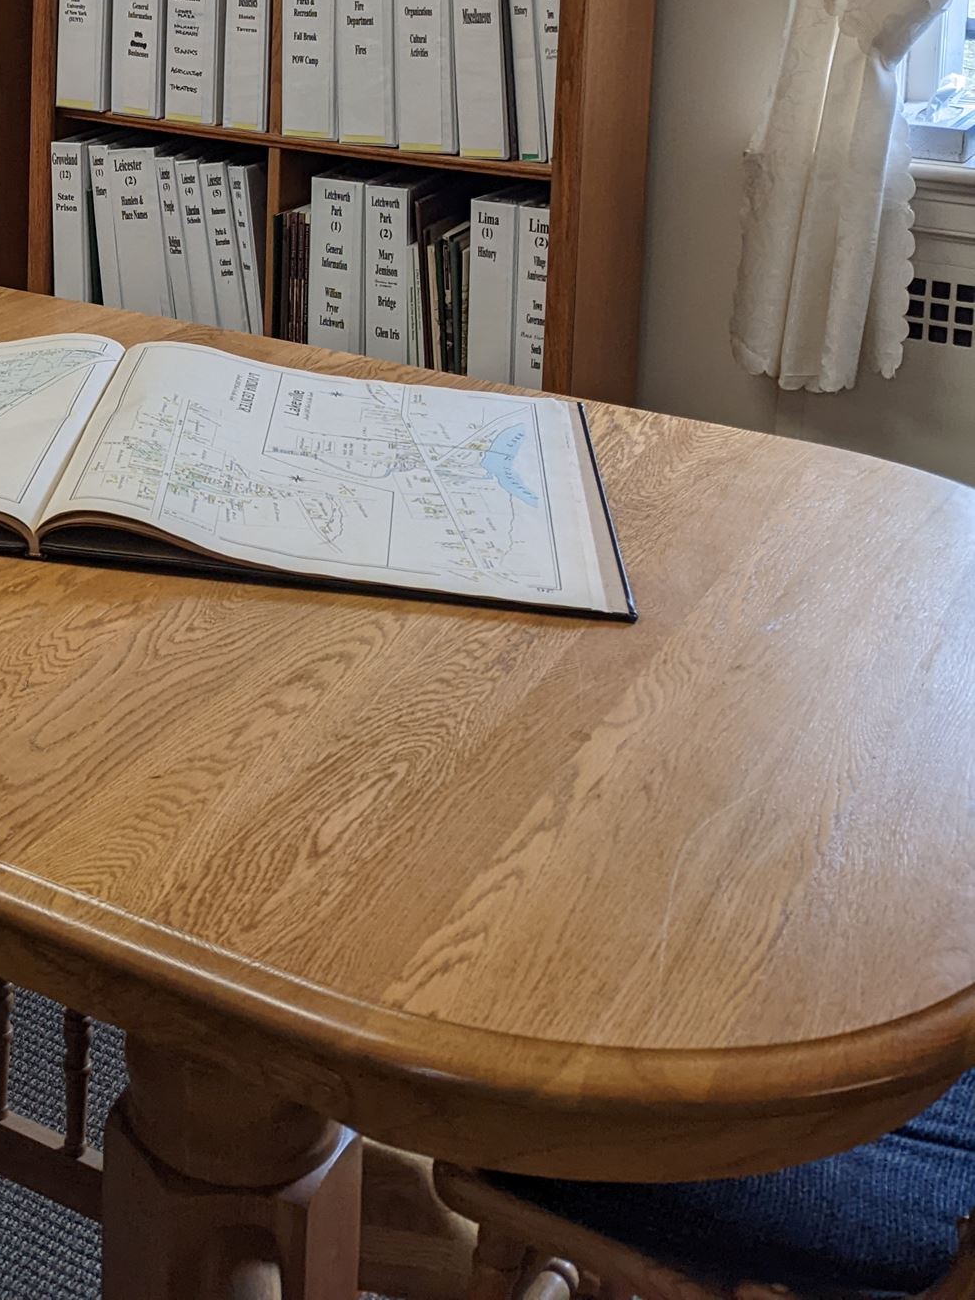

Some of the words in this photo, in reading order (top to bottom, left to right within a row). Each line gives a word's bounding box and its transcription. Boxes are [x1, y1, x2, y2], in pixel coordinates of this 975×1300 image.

[355, 1, 364, 11] Fire
[347, 16, 374, 28] Department
[355, 45, 366, 54] Fires
[114, 159, 142, 172] Leicester
[125, 176, 136, 186] (2)
[58, 193, 74, 201] State
[325, 188, 350, 202] Letchworth
[56, 203, 77, 211] Prison
[372, 196, 399, 209] Letchworth
[331, 205, 342, 217] Park
[380, 213, 392, 224] Park
[479, 212, 499, 225] Lima
[331, 221, 341, 233] (1)
[529, 218, 549, 233] Lim
[380, 228, 392, 240] (2)
[482, 228, 493, 240] (1)
[326, 243, 343, 255] General
[478, 246, 497, 262] History
[379, 249, 393, 263] Mary
[375, 264, 397, 277] Jemison
[378, 296, 396, 310] Bridge
[375, 327, 388, 338] Glen
[390, 329, 399, 340] Iris
